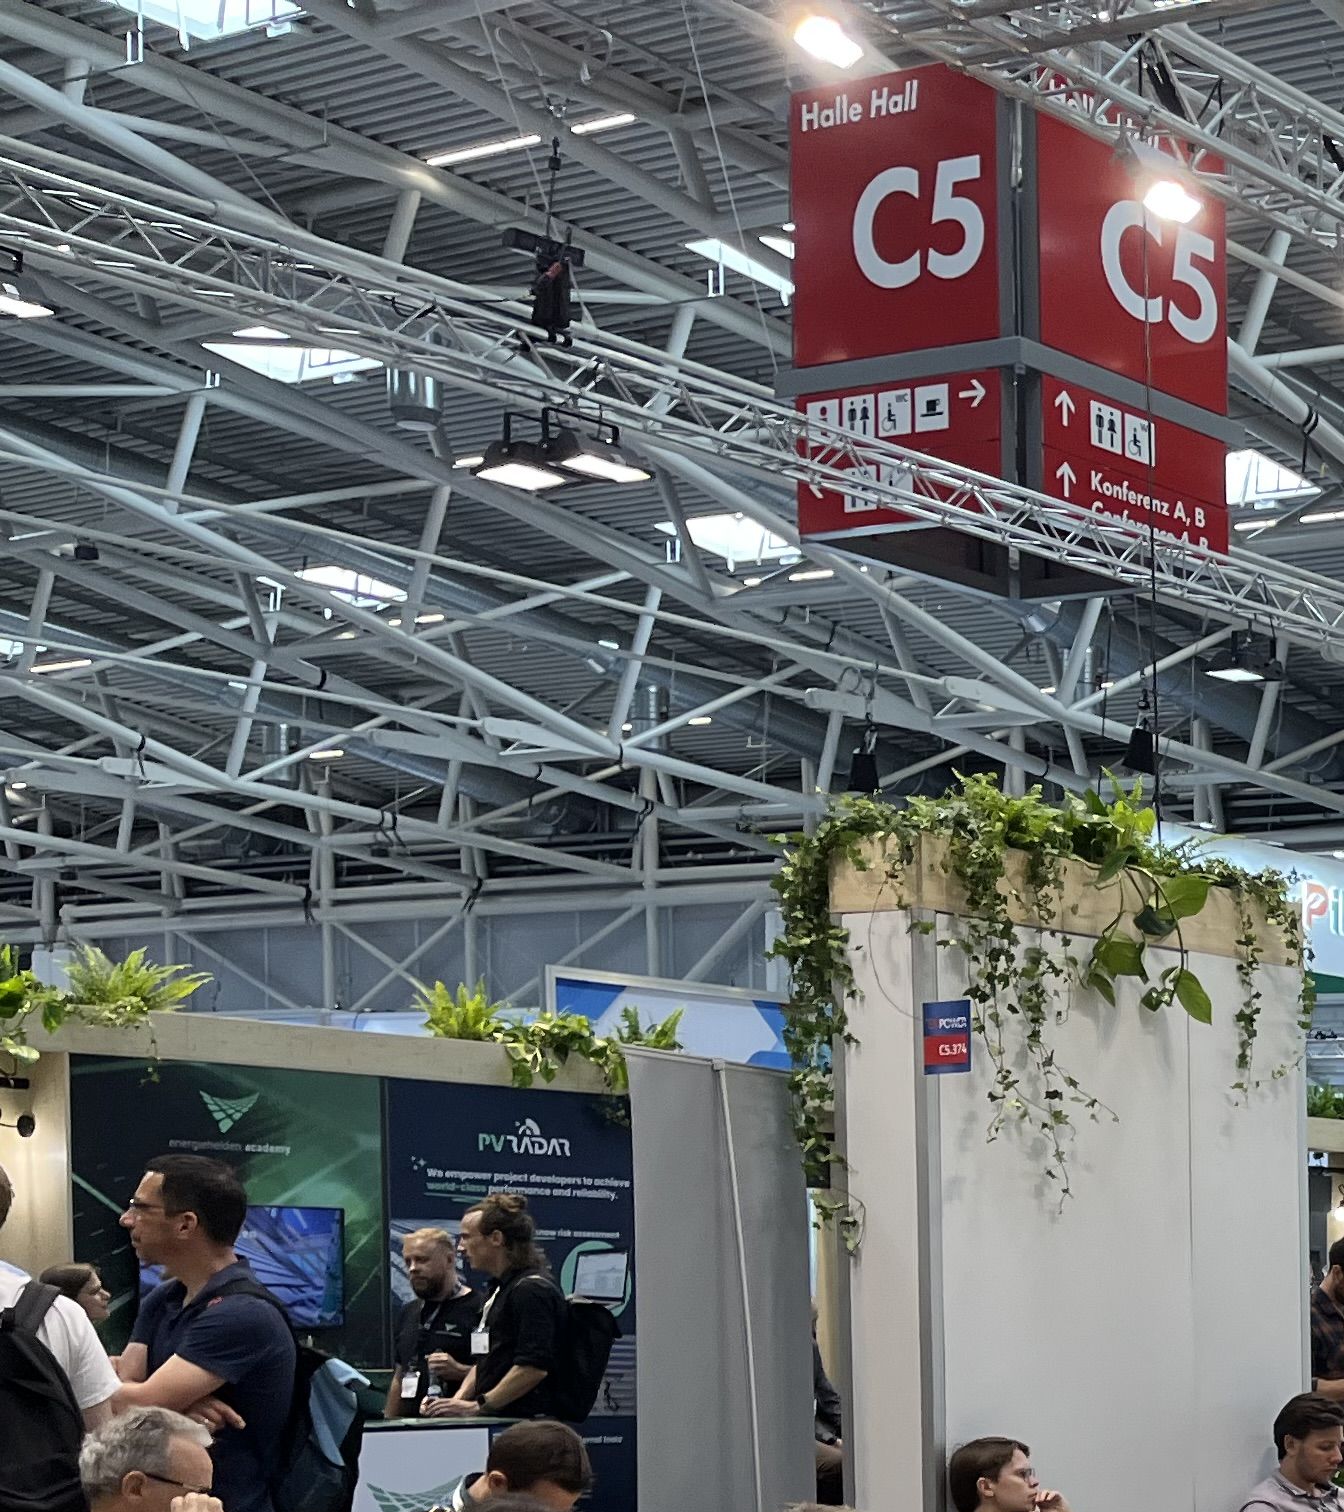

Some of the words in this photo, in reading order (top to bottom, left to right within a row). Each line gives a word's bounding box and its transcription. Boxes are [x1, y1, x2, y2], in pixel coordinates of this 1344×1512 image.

[801, 101, 863, 132] Halle
[869, 79, 918, 118] Hall
[853, 153, 985, 289] C5
[1101, 200, 1218, 344] C5
[1090, 470, 1170, 517] Konferenz
[1173, 501, 1191, 527] A,
[1195, 507, 1206, 528] B
